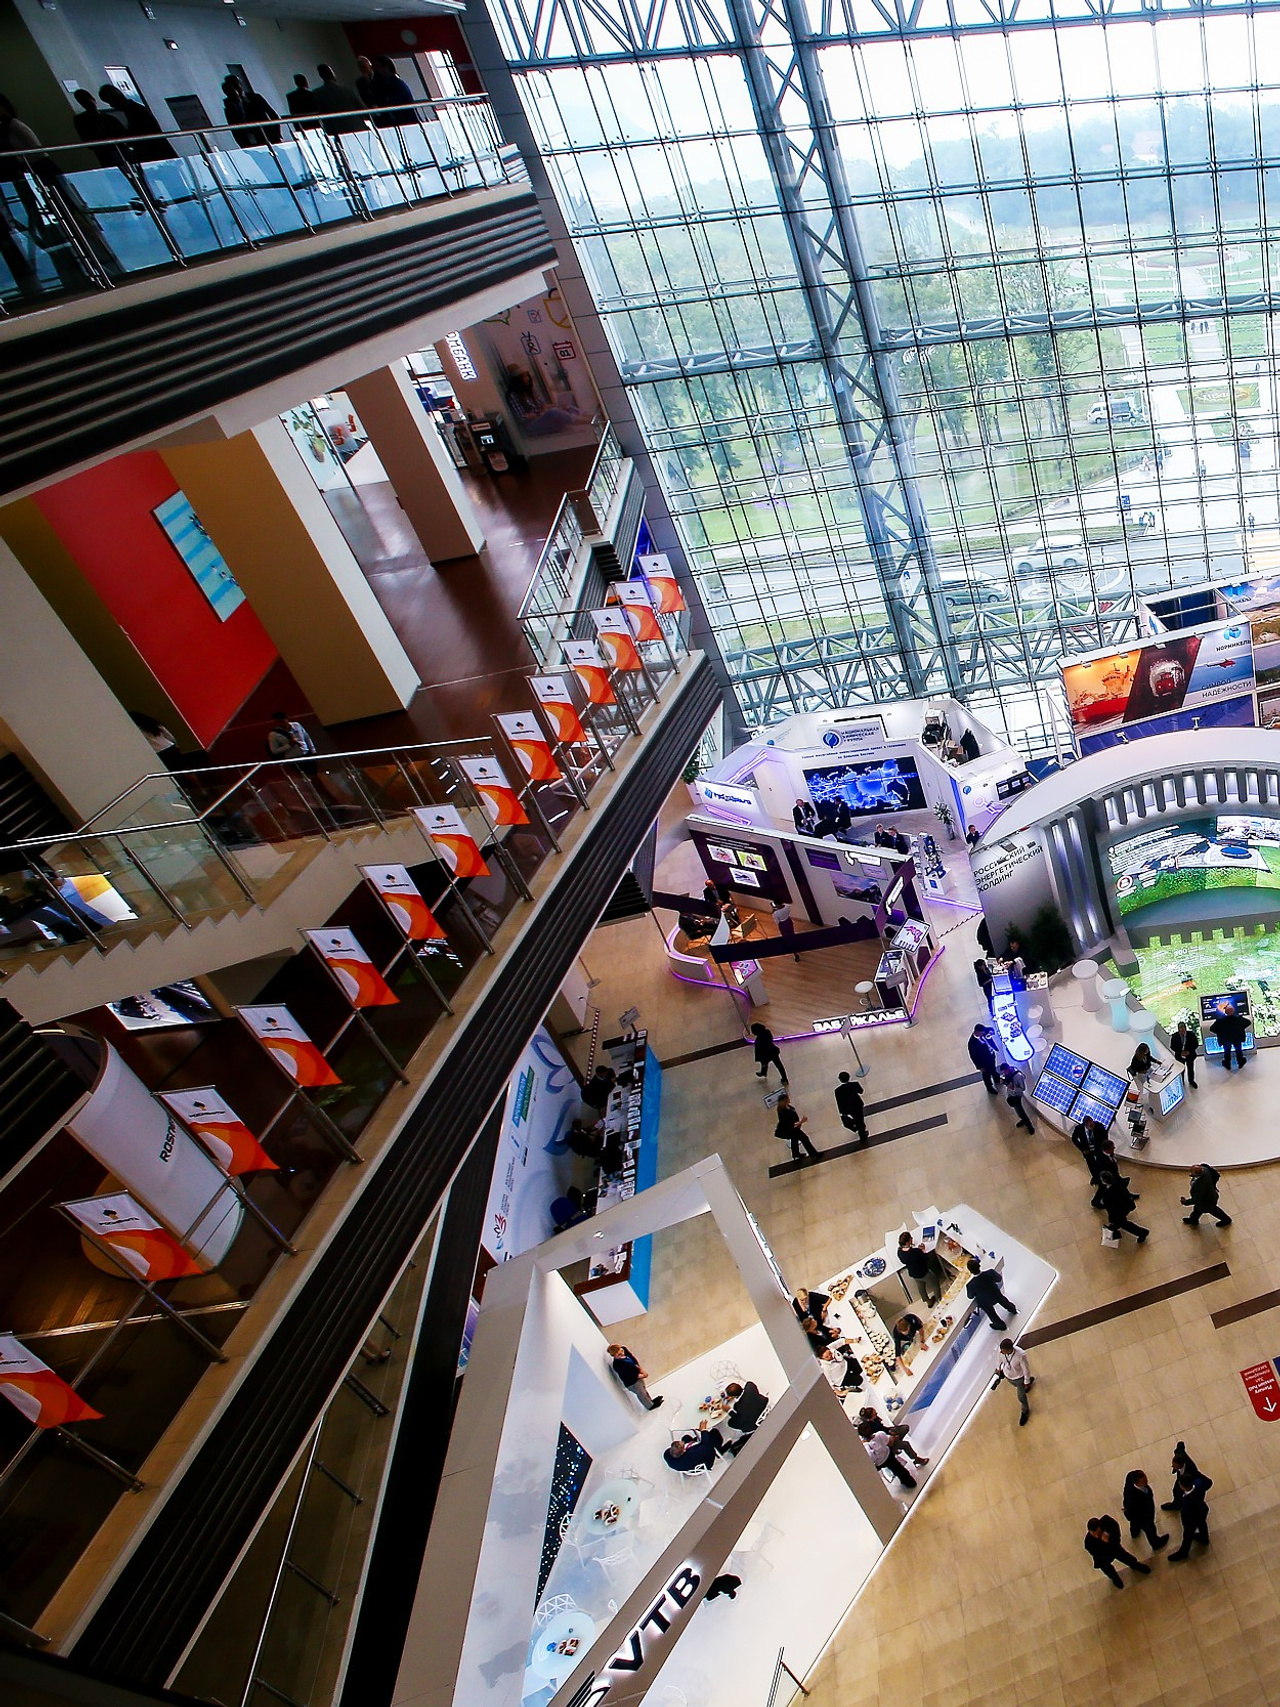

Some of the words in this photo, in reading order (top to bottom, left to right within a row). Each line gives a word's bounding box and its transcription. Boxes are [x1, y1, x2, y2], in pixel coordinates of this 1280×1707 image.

[1201, 678, 1231, 690] СИМВОЛ
[1202, 681, 1252, 698] НАДЕЖНОСТИ
[975, 845, 1043, 886] ЭНЕРГЕТИЧЕСКИЙ
[977, 870, 1014, 893] ХОЛДИНГ
[608, 1567, 701, 1671] VTB
